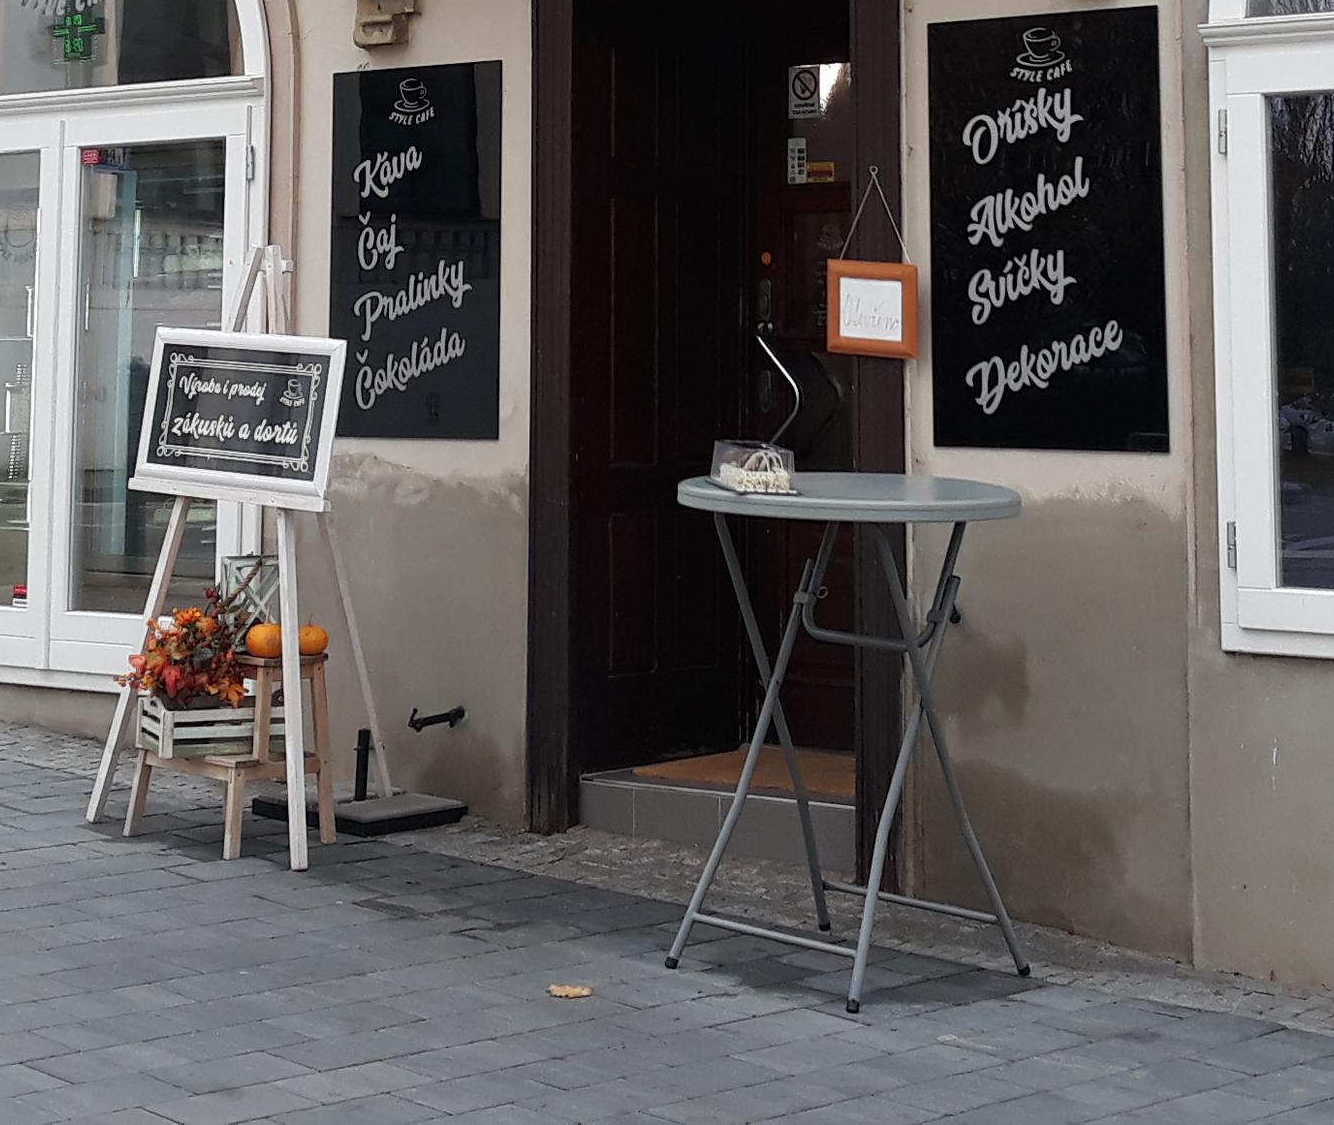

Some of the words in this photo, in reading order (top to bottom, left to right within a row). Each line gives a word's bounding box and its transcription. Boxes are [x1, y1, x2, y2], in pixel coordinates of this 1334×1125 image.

[1009, 66, 1044, 83] STYLE
[962, 87, 1084, 165] Oříšky
[353, 145, 423, 200] Káva
[967, 156, 1090, 248] Alkohol
[357, 210, 405, 271] Čaj
[353, 258, 473, 342] Pralinky
[967, 248, 1078, 326] Svíčky
[179, 372, 222, 400] Výroba
[222, 379, 229, 395] i
[228, 379, 267, 406] prodej
[355, 327, 466, 411] Čokoláda
[965, 319, 1123, 415] Dekorace
[171, 413, 235, 441] zákusků
[238, 425, 251, 441] a
[253, 418, 299, 445] dortů
